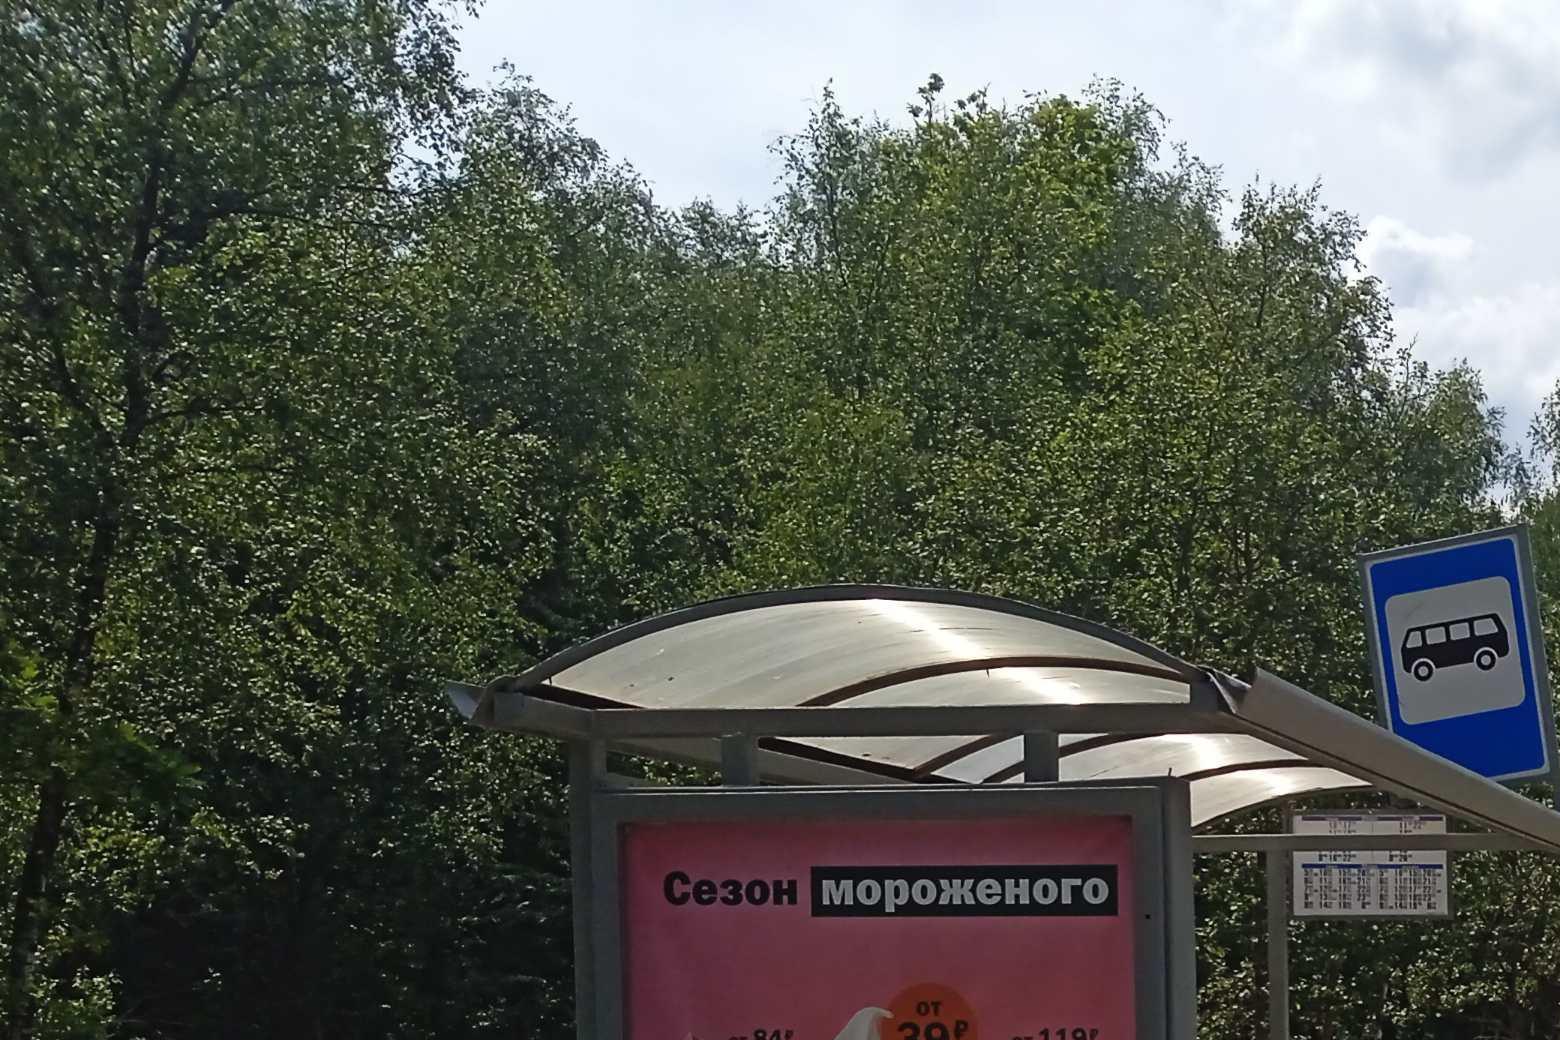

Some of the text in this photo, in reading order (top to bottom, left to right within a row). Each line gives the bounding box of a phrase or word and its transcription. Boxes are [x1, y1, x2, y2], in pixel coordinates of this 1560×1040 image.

[662, 870, 1109, 913] Сезон мороженого
[916, 1001, 942, 1016] от
